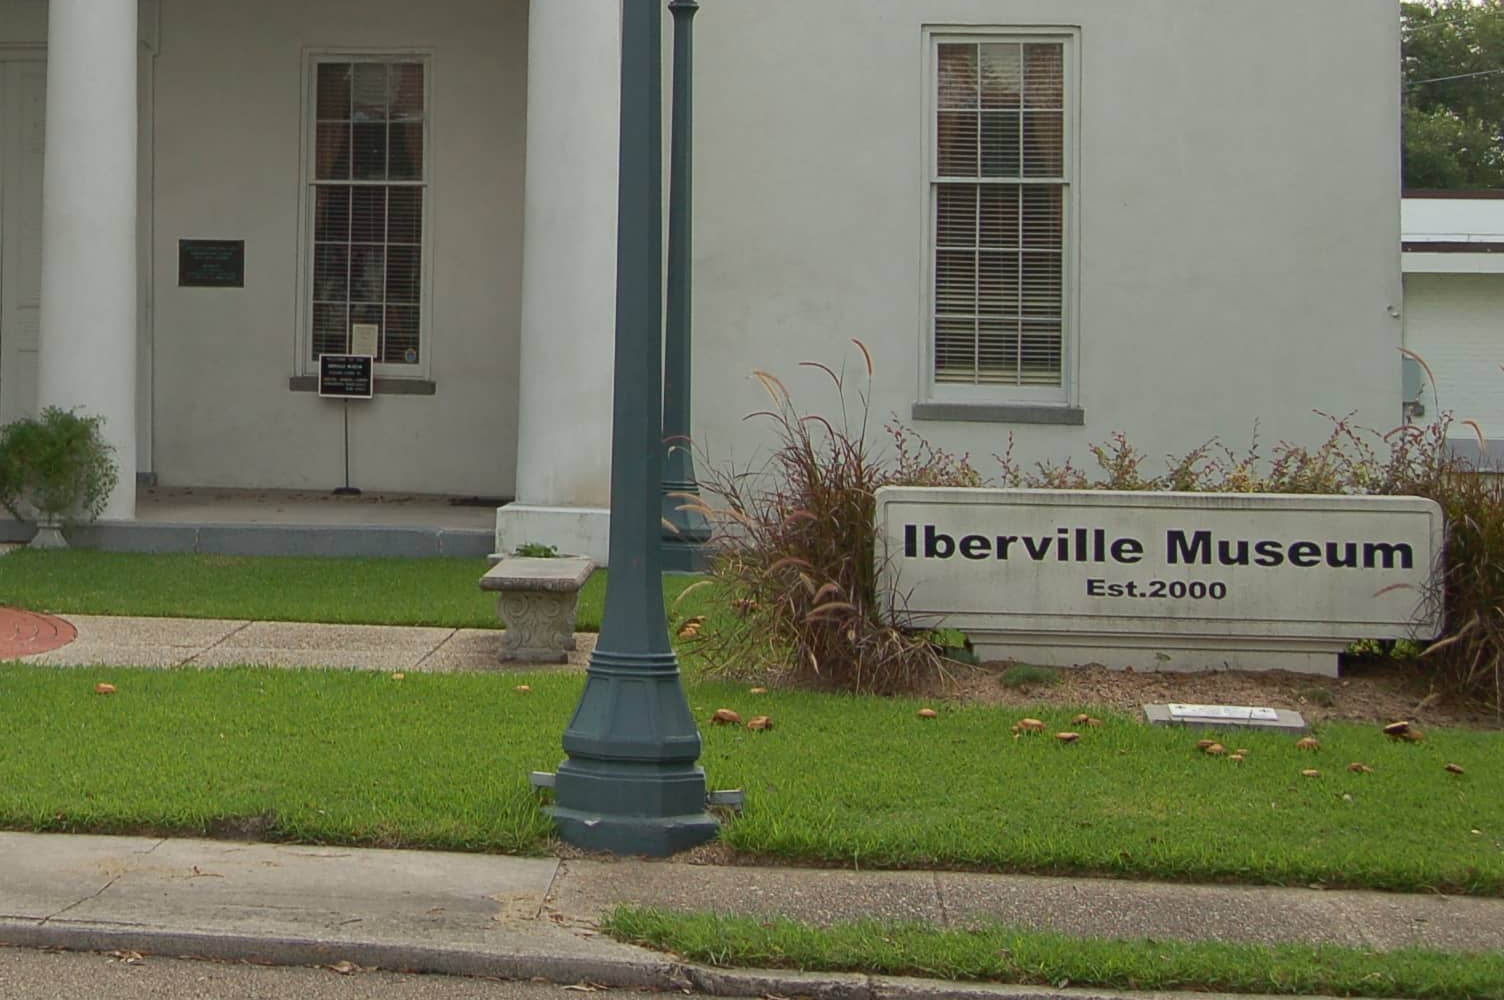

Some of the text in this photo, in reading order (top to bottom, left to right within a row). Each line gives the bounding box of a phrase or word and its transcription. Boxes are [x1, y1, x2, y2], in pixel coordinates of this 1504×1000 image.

[904, 524, 1414, 569] Iberville Museum
[1086, 578, 1227, 600] Est.2000
